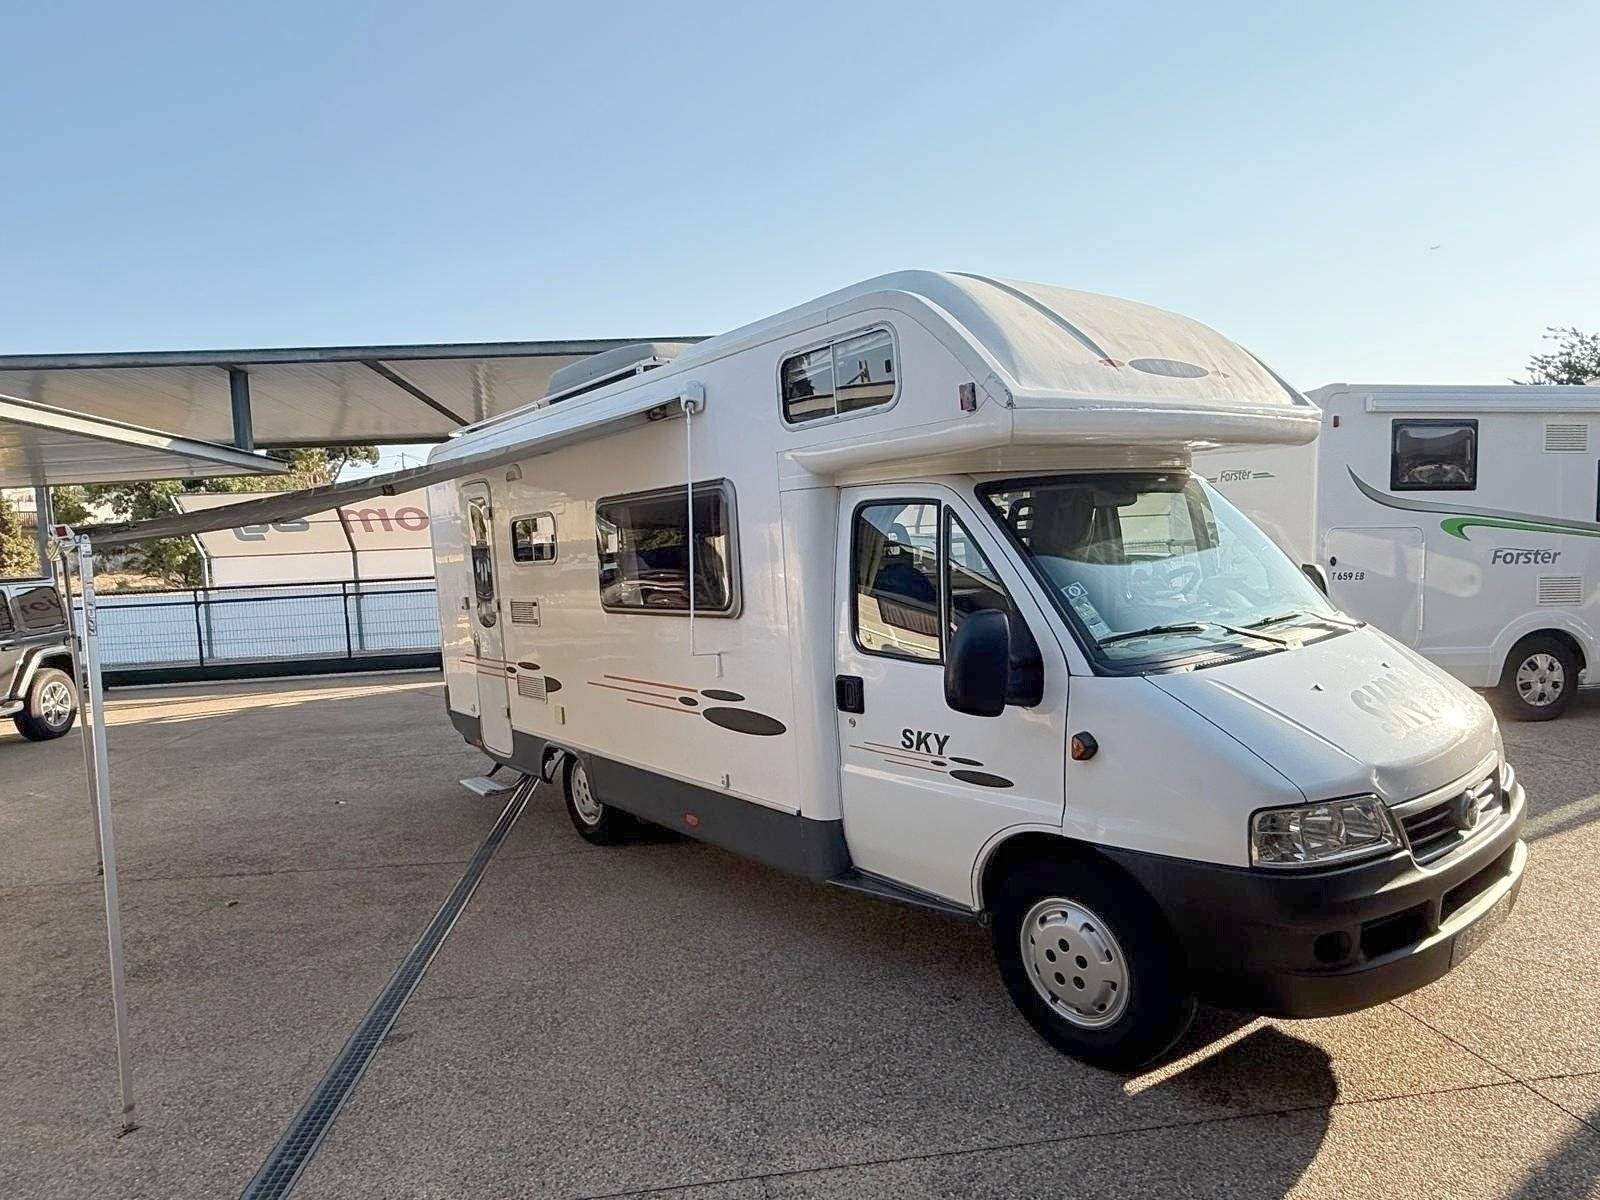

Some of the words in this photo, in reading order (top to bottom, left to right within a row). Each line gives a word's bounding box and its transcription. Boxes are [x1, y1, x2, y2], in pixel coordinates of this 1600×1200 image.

[1220, 470, 1252, 482] Forster
[1491, 548, 1561, 565] Forster
[1332, 572, 1336, 580] T
[1337, 572, 1353, 580] 659
[1355, 572, 1365, 580] EB
[901, 728, 950, 755] SKY
